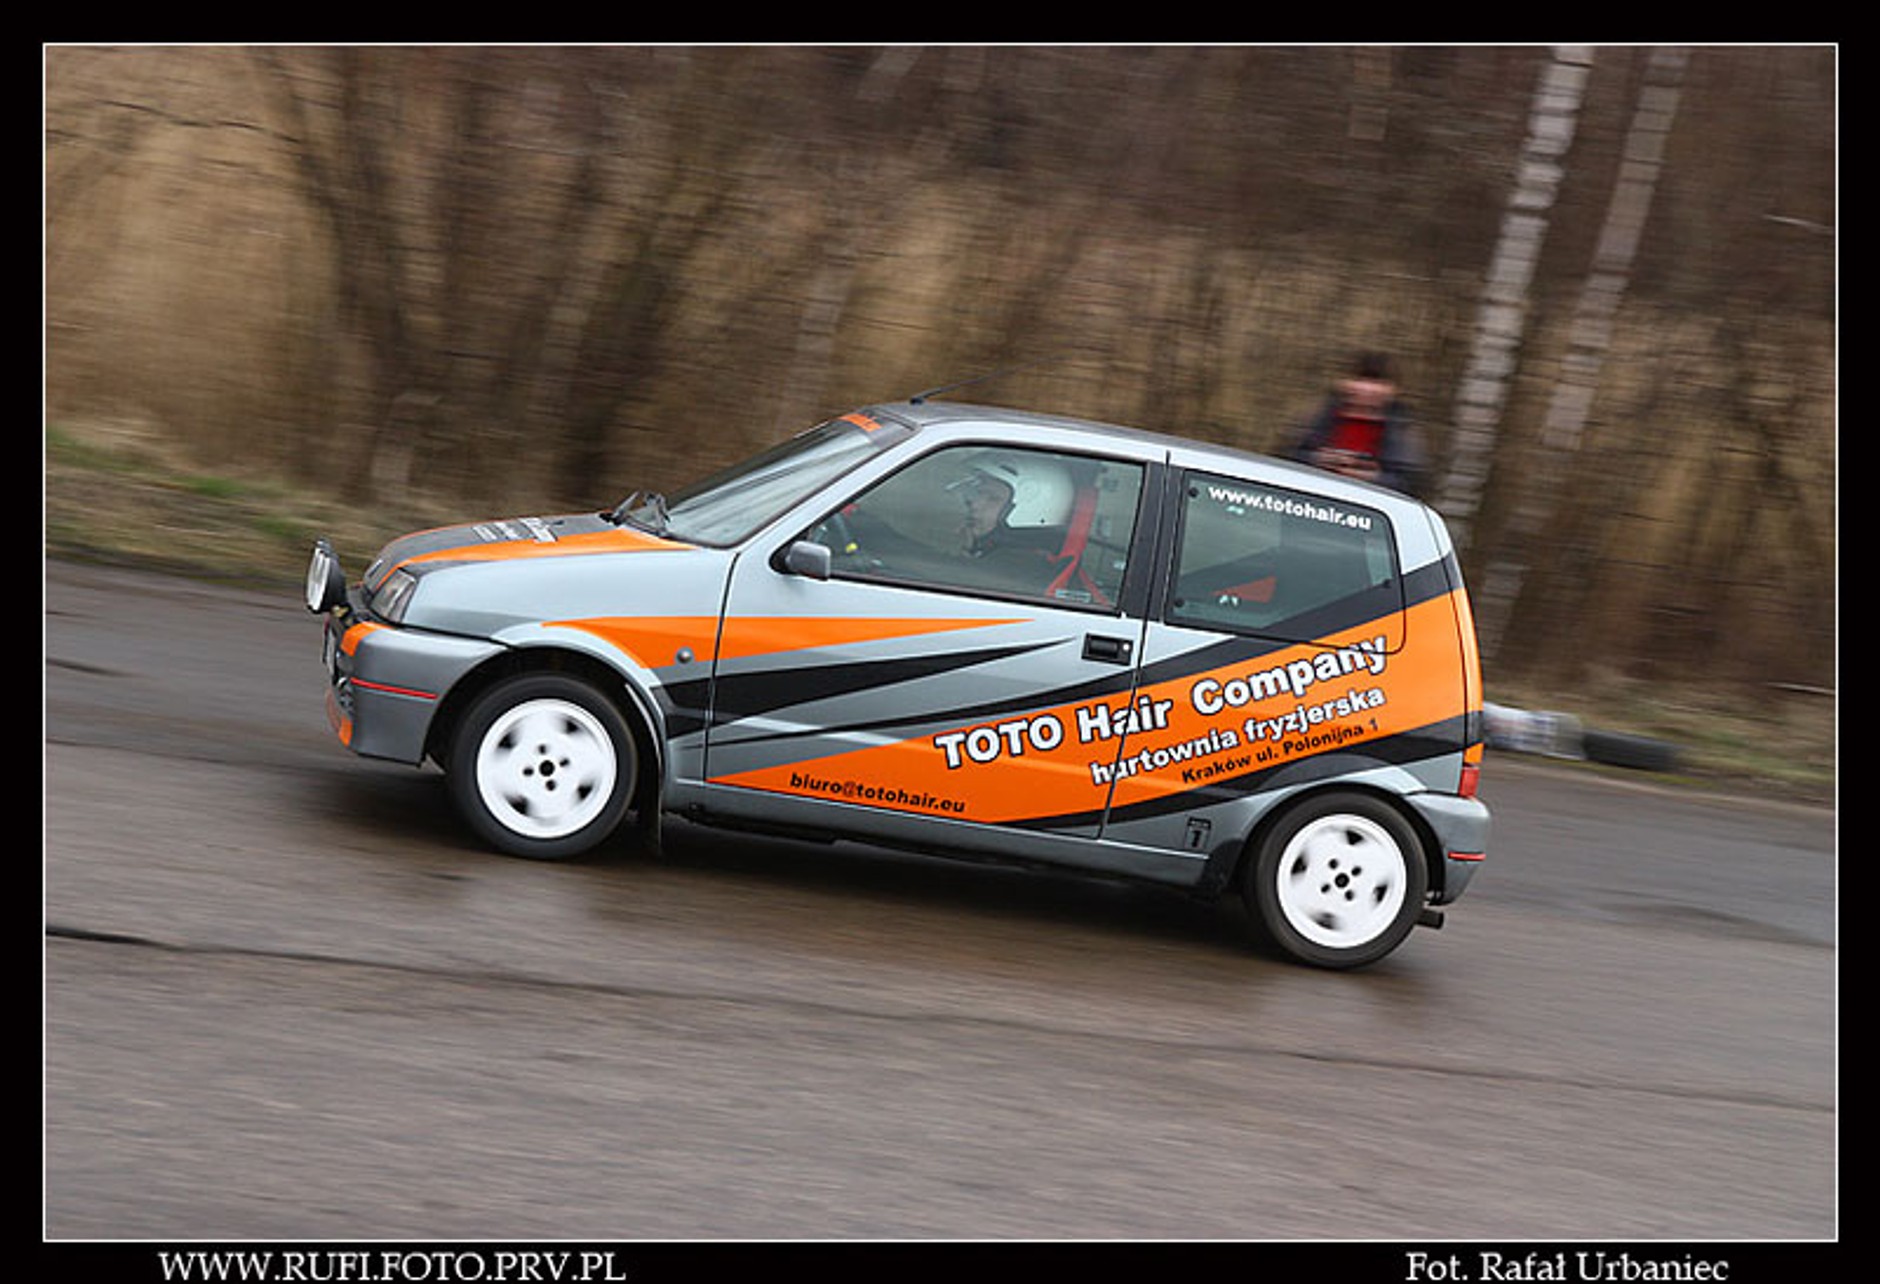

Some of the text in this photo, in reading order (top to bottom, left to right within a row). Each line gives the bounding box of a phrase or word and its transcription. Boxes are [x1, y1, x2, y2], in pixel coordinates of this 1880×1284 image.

[1208, 486, 1371, 530] www.totohair.eu
[934, 634, 1388, 770] TOTO Hair Company
[1090, 686, 1387, 785] hurtownia fryzjerska
[1182, 717, 1380, 783] Kraków ul. Polonijna 1
[789, 771, 966, 813] biuro@totohair.eu
